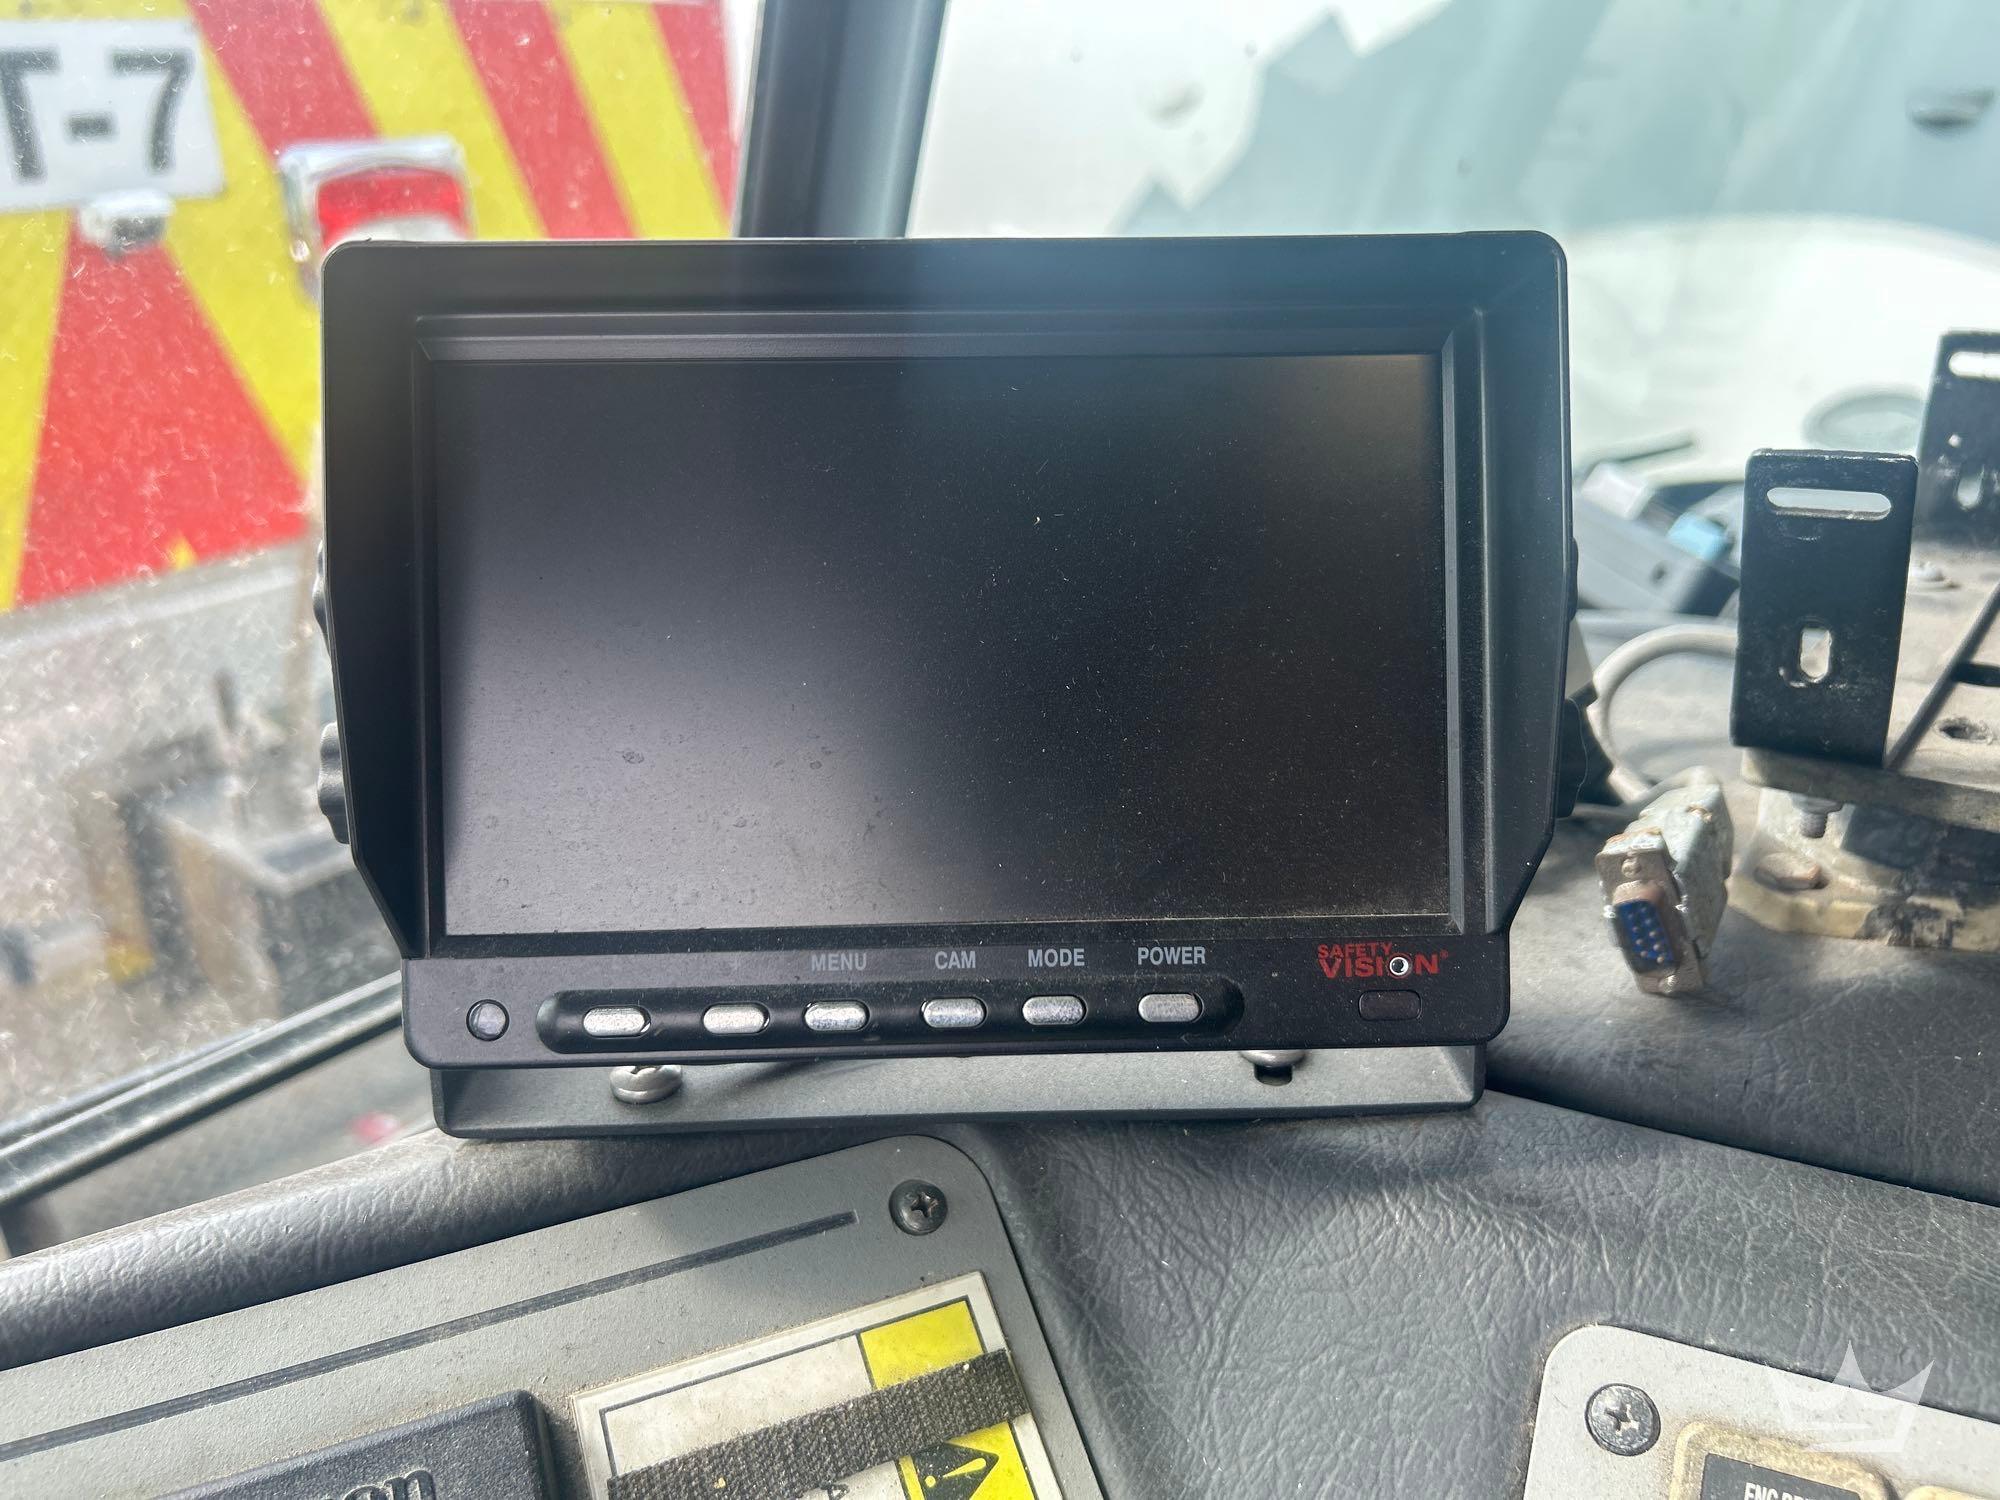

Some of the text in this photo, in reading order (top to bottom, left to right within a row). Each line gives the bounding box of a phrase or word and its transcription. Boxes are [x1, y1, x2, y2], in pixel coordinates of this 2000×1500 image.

[811, 945, 1206, 972] MENU CAM MODE POWER
[1317, 941, 1393, 958] SAFETY
